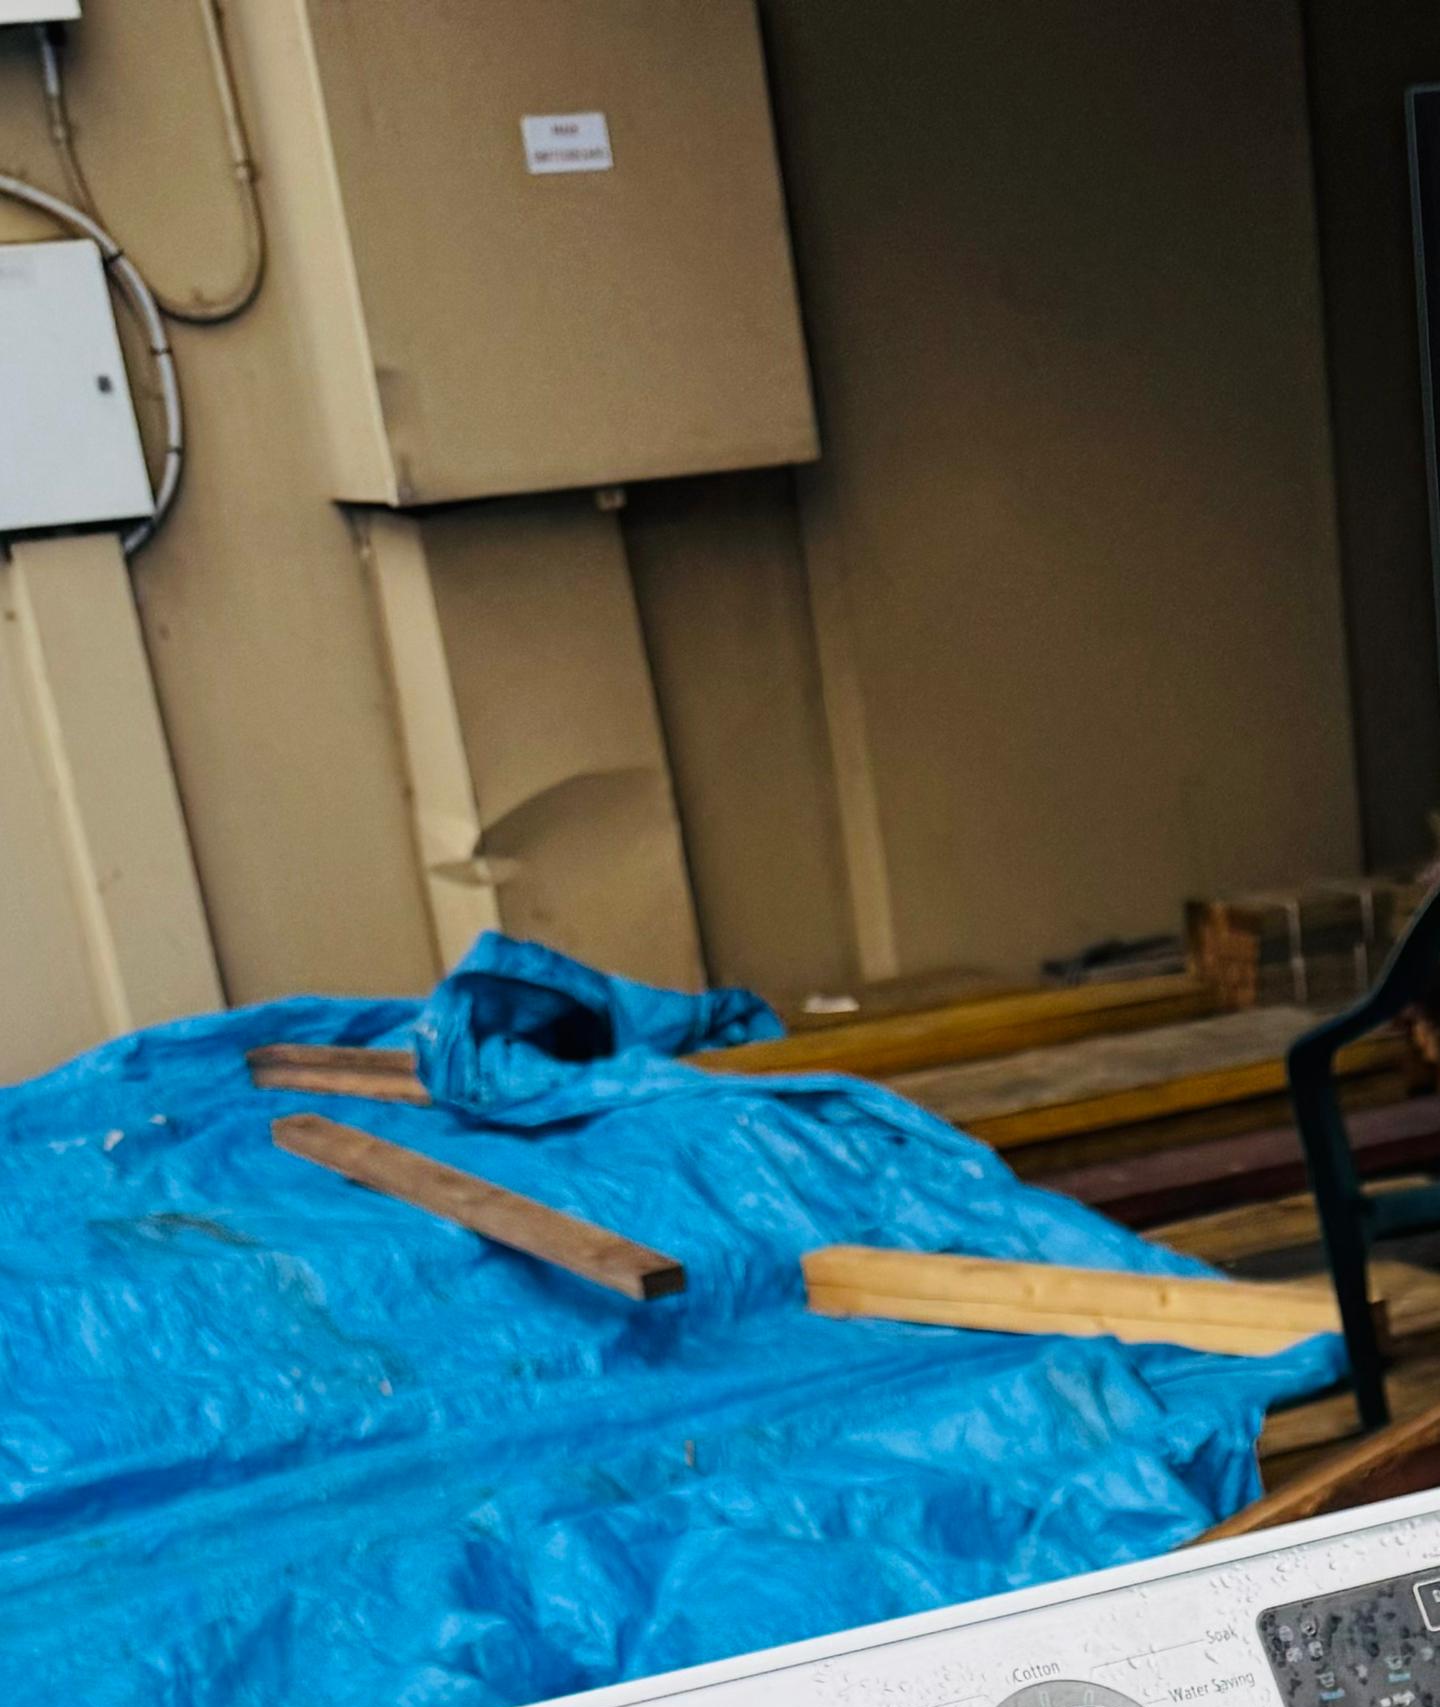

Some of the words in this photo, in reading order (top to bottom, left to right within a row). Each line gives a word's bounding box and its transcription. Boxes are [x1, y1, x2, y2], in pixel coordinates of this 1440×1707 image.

[1205, 1625, 1238, 1644] Soak
[1012, 1662, 1060, 1682] Cotton
[1168, 1684, 1209, 1702] Water
[1211, 1672, 1256, 1693] Saving
